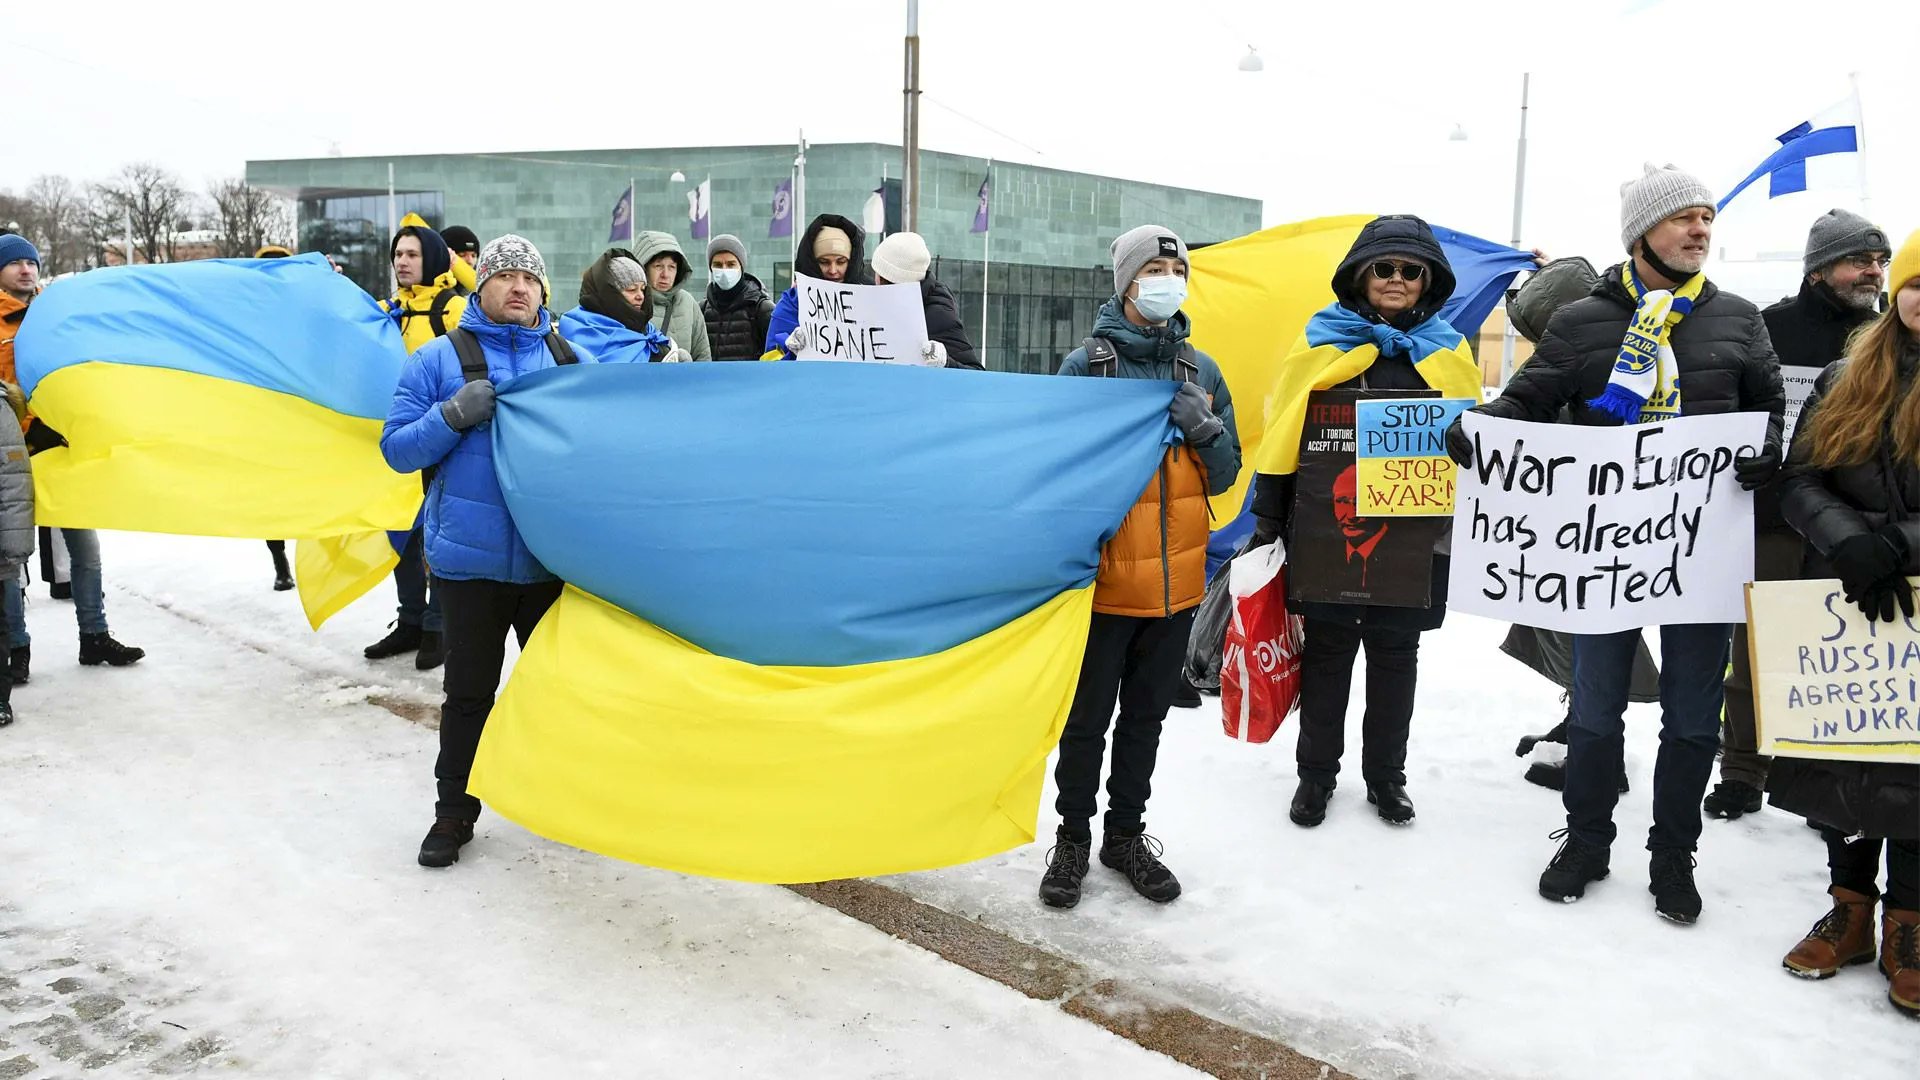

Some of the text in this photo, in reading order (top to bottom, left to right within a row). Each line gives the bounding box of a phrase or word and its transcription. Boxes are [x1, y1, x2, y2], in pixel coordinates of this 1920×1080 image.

[807, 286, 857, 324] SAME
[1783, 376, 1814, 386] seapu
[1311, 404, 1355, 424] TERR
[1381, 404, 1445, 428] STOP
[1307, 441, 1356, 452] ACCEPT IT AND
[1321, 428, 1354, 440] I TORTURE
[1365, 429, 1445, 454] PUTIN
[1384, 459, 1451, 481] STOP
[1475, 427, 1757, 505] War in Europe
[1471, 492, 1702, 557] has already
[1482, 542, 1683, 613] started
[1798, 640, 1920, 675] RUSSIA
[1845, 706, 1920, 733] UKR
